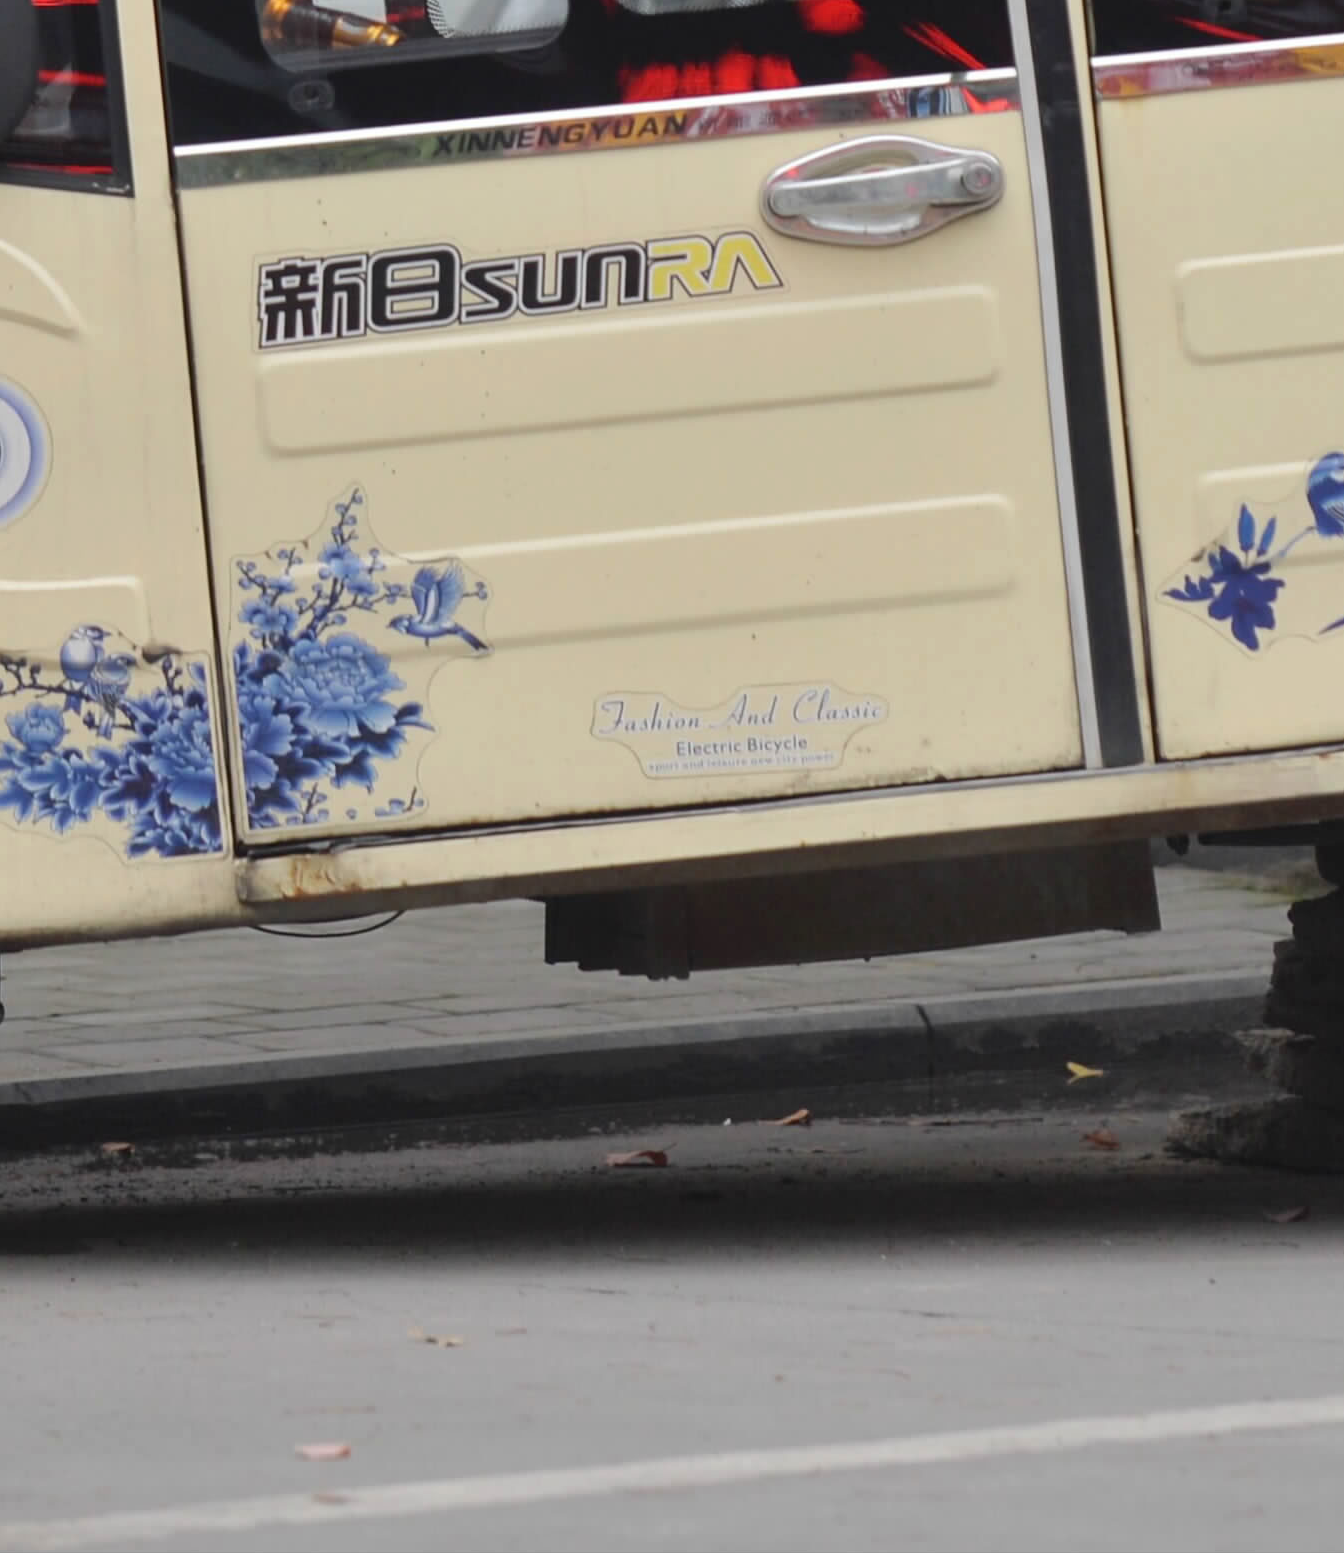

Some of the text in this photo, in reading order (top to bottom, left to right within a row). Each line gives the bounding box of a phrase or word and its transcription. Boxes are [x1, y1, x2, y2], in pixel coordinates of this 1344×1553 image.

[431, 114, 687, 156] XINNENGYUAN
[598, 688, 884, 735] Fashion And Classic
[675, 732, 808, 758] Electric Bicycle
